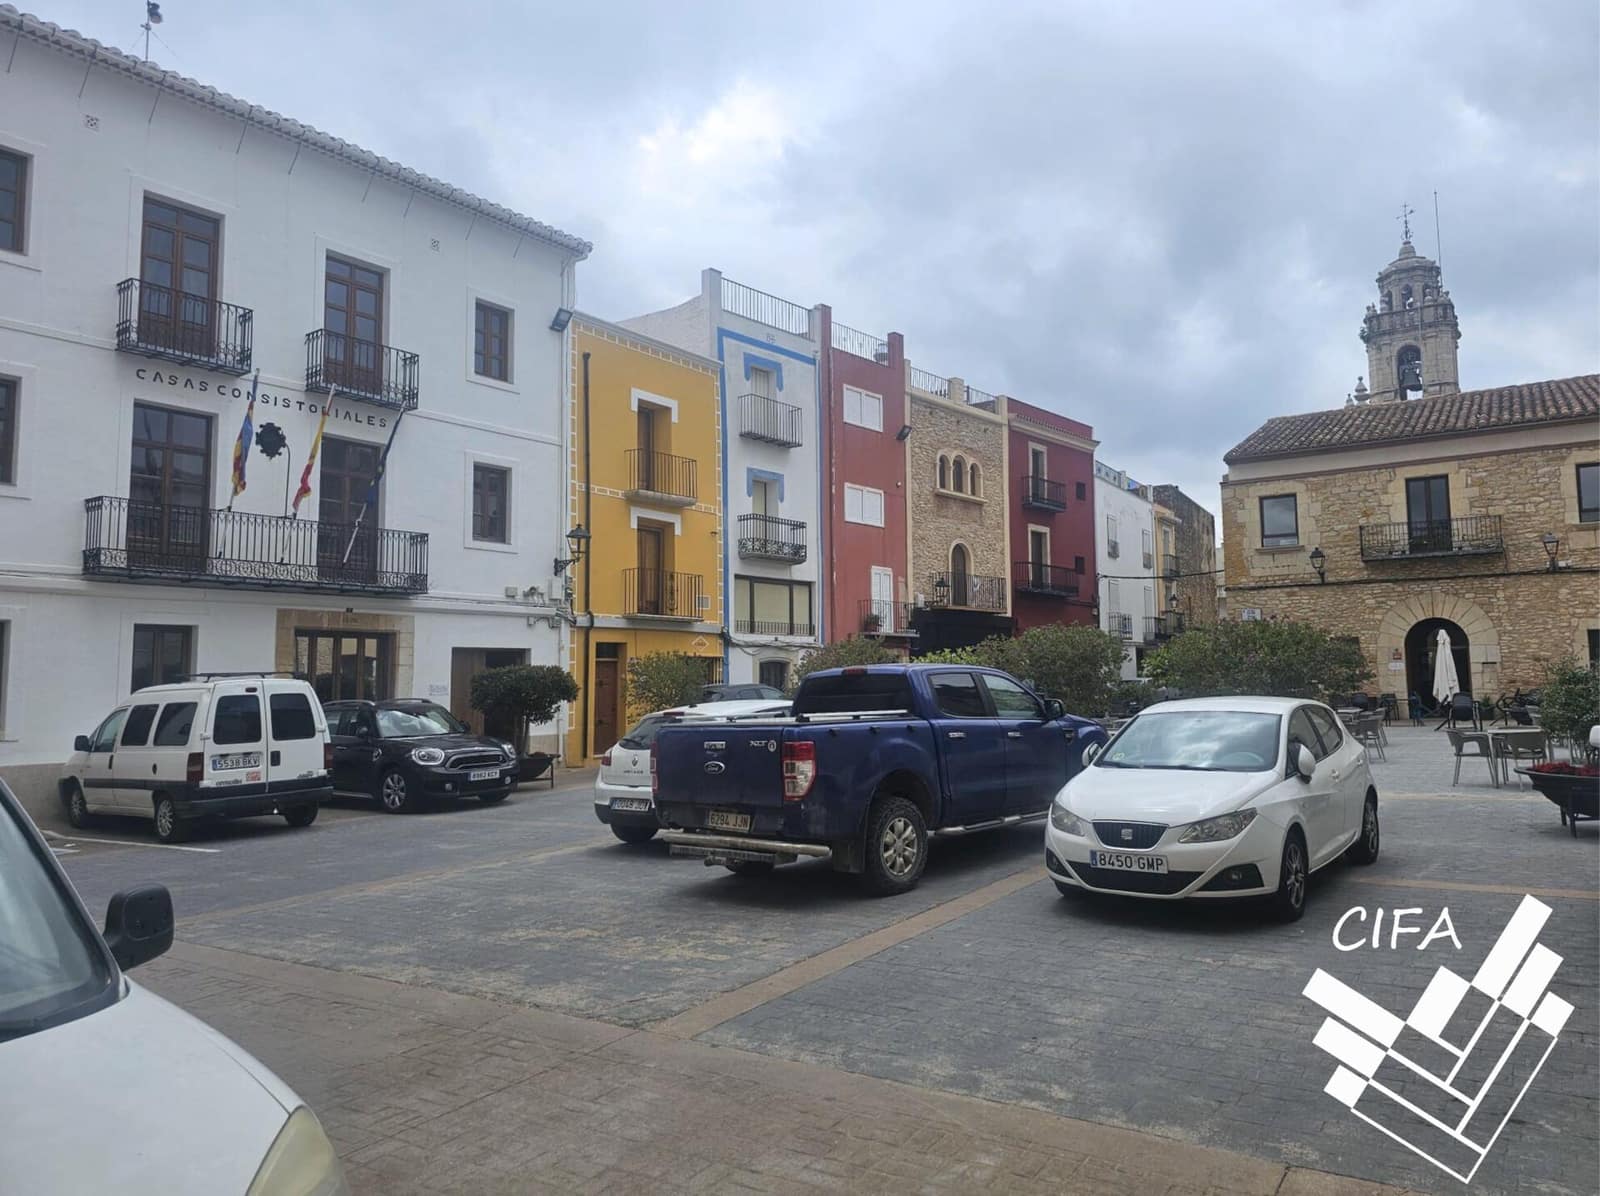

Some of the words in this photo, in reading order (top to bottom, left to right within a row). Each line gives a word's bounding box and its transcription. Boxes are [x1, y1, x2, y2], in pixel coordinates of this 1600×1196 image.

[136, 368, 208, 392] CASAS
[1099, 853, 1132, 869] 8450
[1137, 857, 1164, 872] GMP
